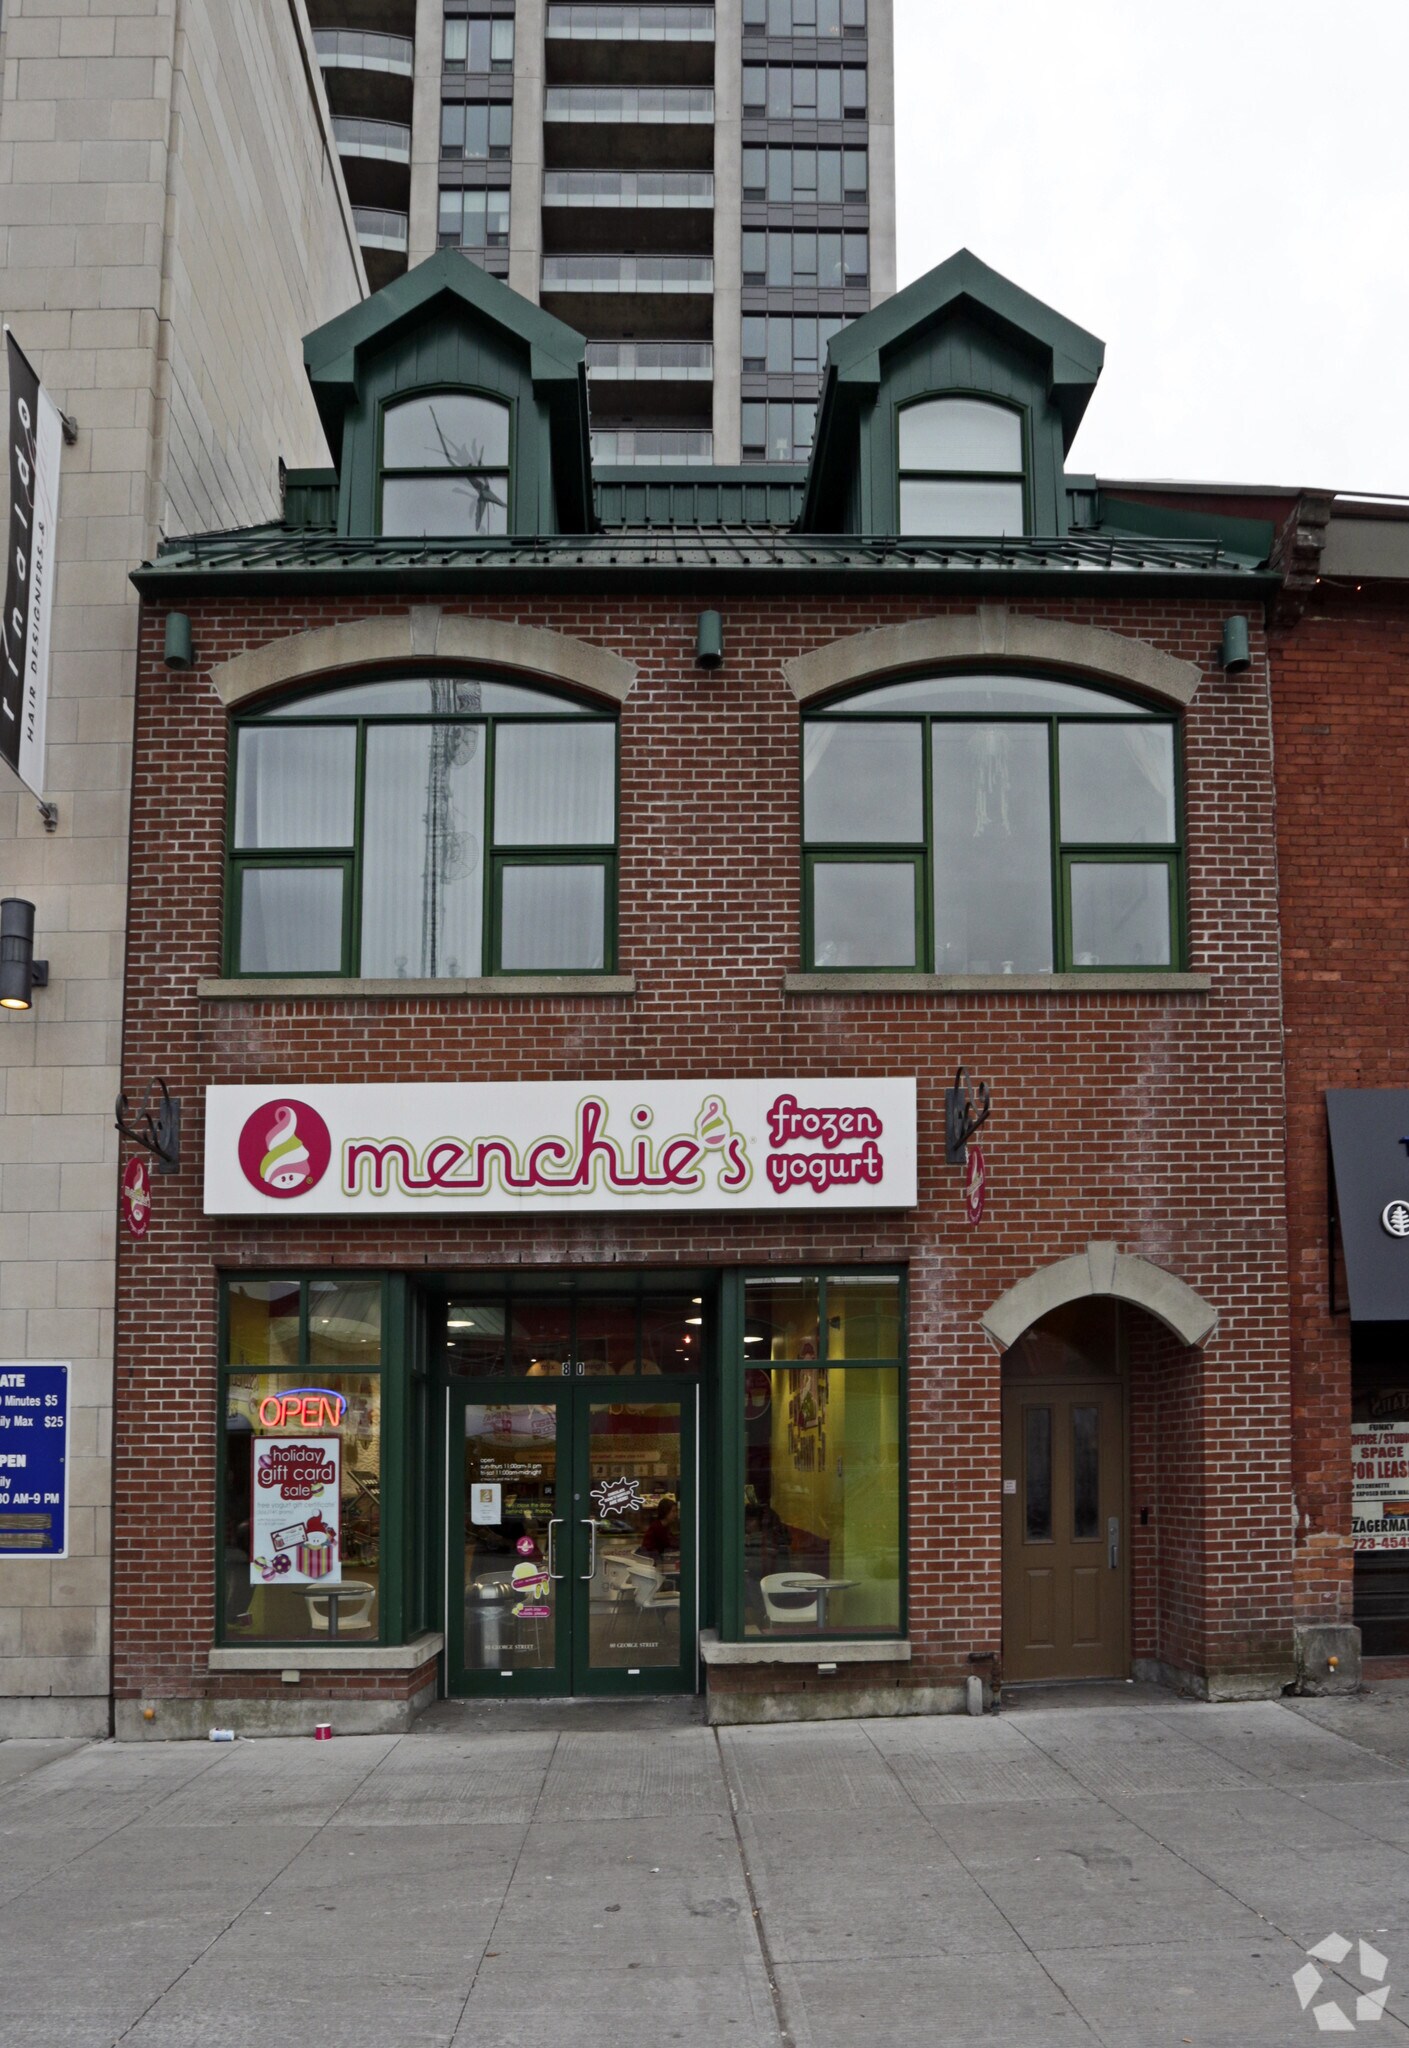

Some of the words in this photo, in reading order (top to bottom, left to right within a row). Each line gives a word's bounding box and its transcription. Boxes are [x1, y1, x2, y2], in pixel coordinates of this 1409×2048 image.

[30, 545, 44, 675] DESIGNERS
[26, 686, 37, 743] HAIR
[770, 1098, 878, 1144] frozen
[346, 1099, 750, 1192] menchie's
[770, 1146, 879, 1187] yogurt
[5, 1395, 41, 1407] Minutes
[45, 1394, 58, 1407] $5
[259, 1396, 342, 1427] OPEN
[14, 1415, 34, 1427] Max
[44, 1416, 64, 1428] $25
[1368, 1423, 1395, 1431] FUNKY
[273, 1449, 322, 1464] holiday
[1360, 1446, 1404, 1459] SPACE
[261, 1464, 289, 1485] gift
[292, 1464, 333, 1481] card
[1377, 1460, 1409, 1479] LEAS
[44, 1492, 60, 1505] PM
[283, 1483, 311, 1497] sale
